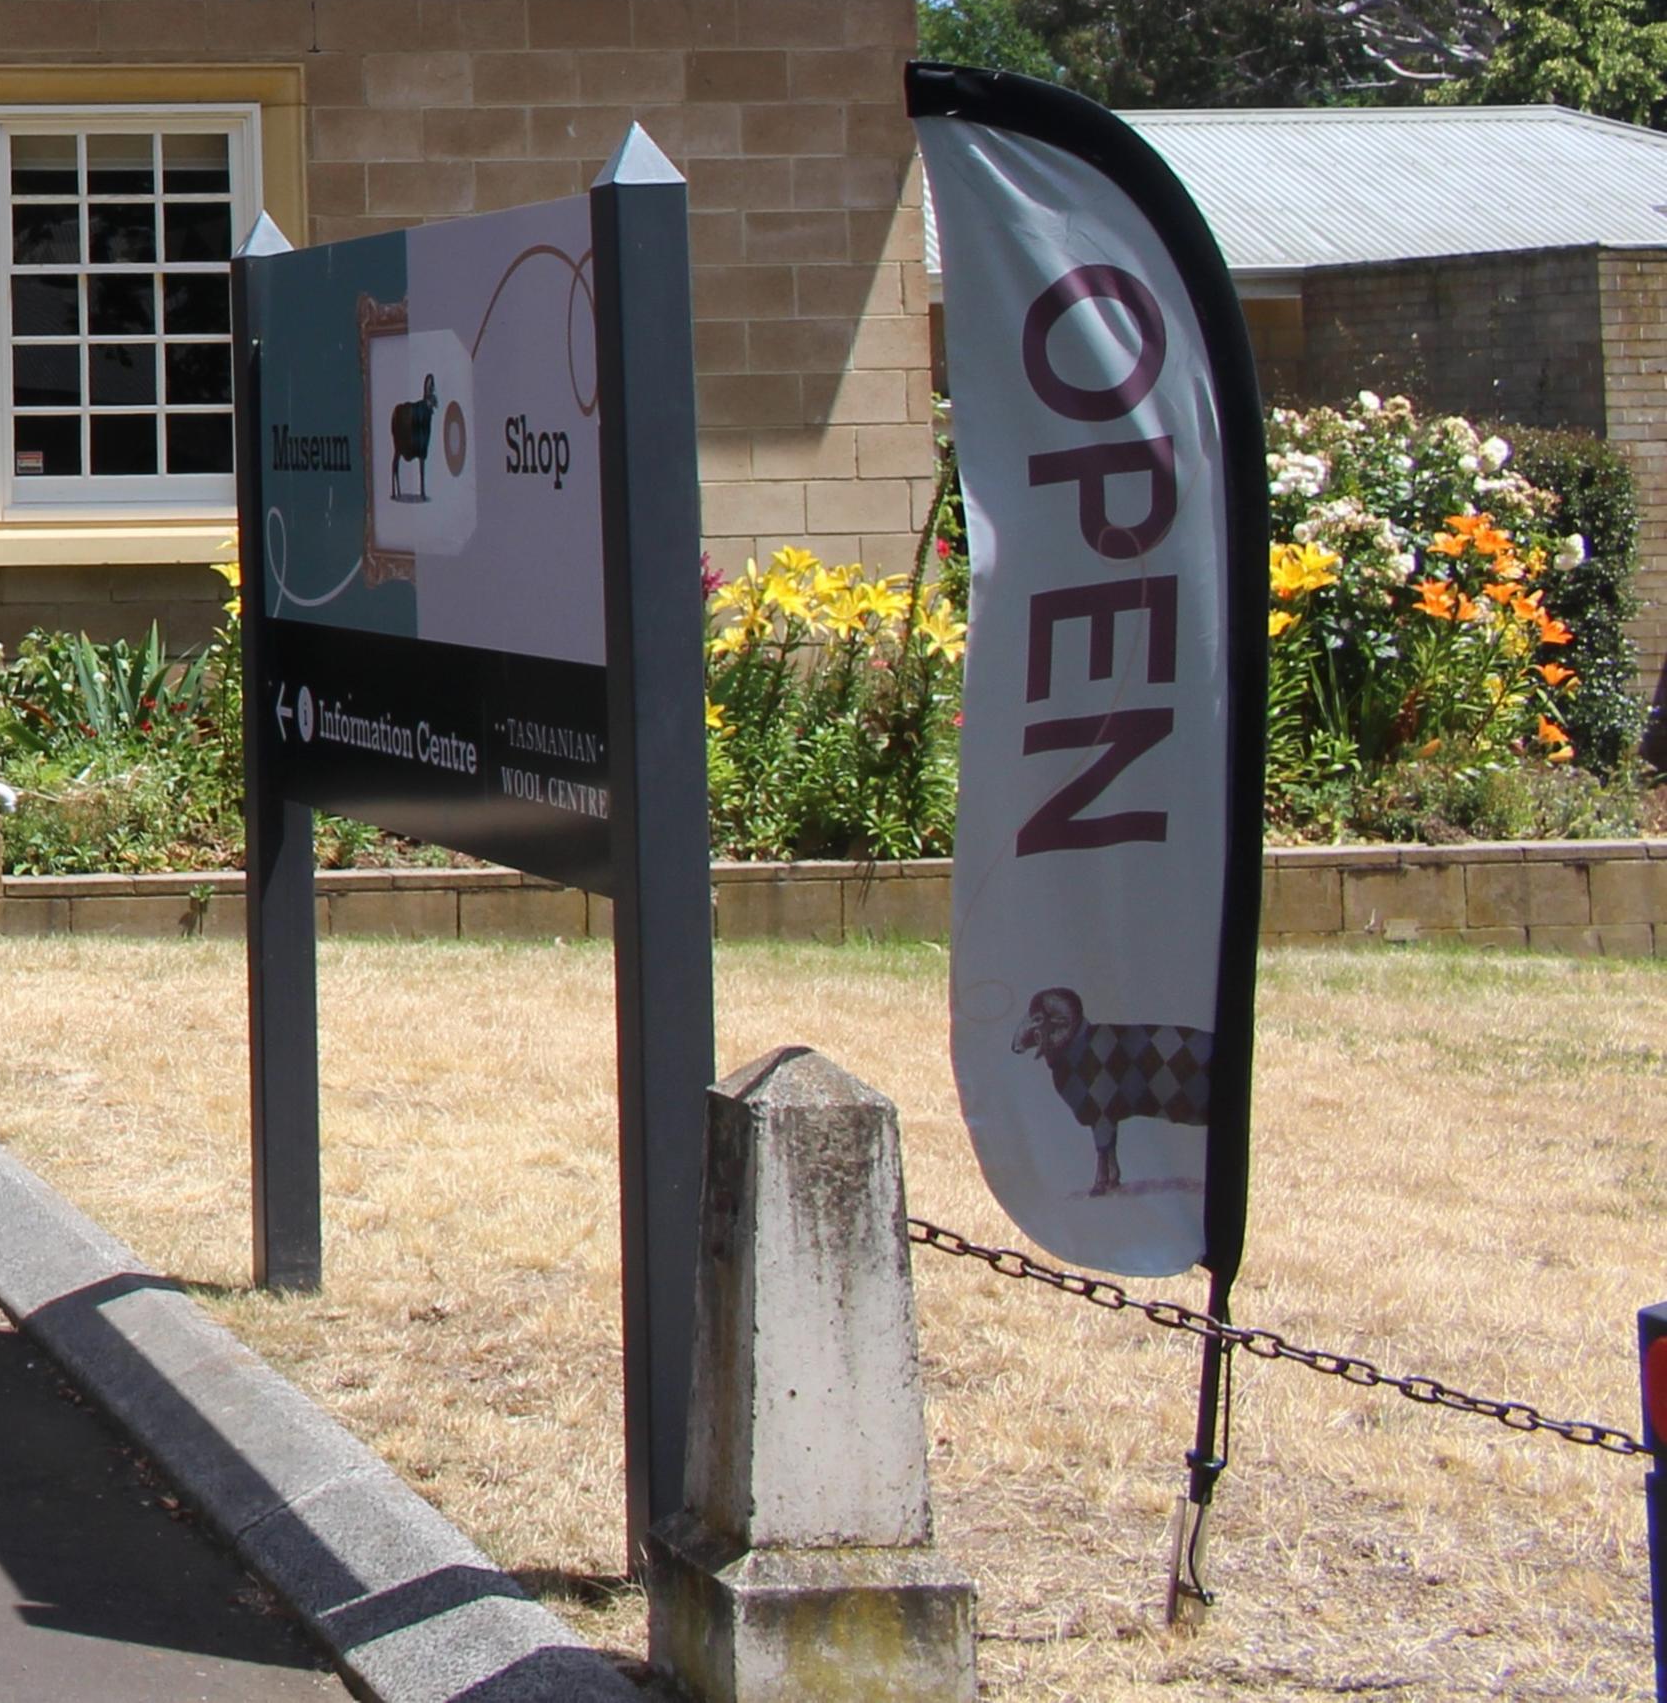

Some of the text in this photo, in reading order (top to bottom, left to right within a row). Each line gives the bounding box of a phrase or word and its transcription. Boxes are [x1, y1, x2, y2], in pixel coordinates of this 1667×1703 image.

[272, 424, 351, 472] Museum
[505, 414, 570, 489] Shop
[1016, 261, 1179, 858] OPEN
[319, 699, 413, 760] Information
[417, 721, 477, 775] Centre
[507, 718, 597, 763] TASMANIAN
[501, 766, 609, 820] WOOL CENTRE
